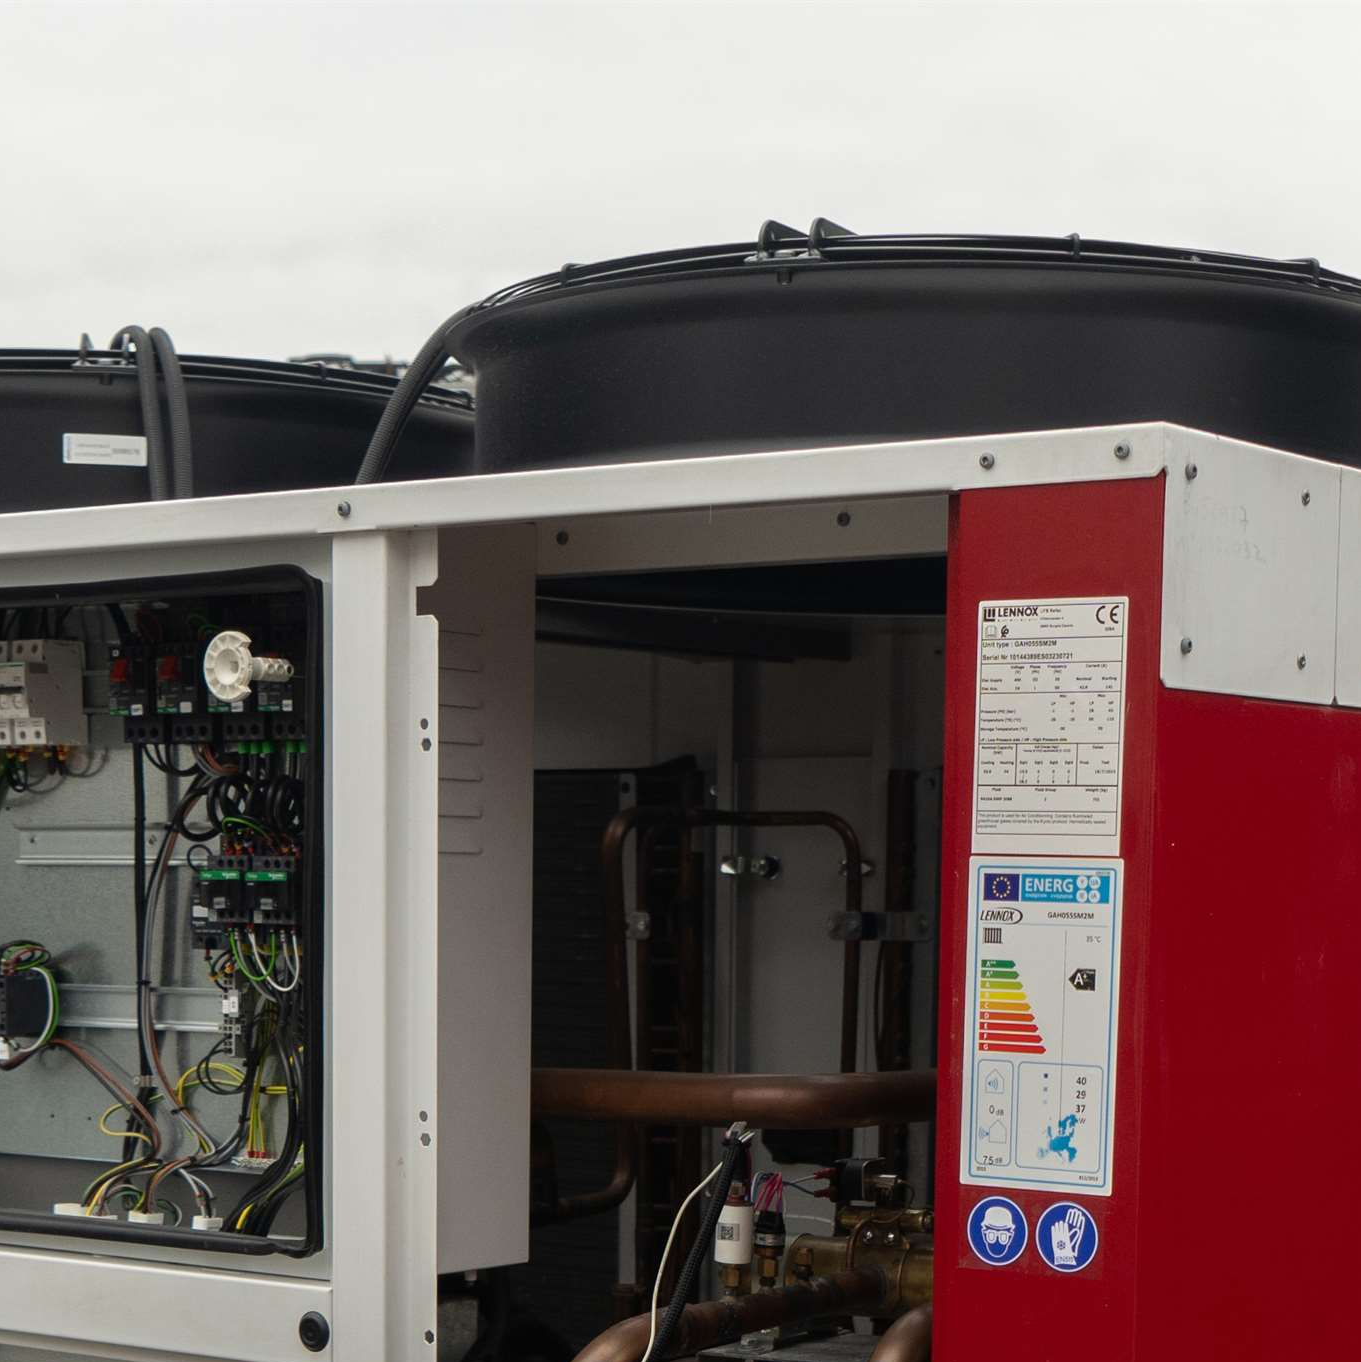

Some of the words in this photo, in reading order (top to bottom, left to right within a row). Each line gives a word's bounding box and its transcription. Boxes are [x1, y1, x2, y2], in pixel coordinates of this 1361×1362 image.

[998, 606, 1038, 618] LENNOX
[996, 641, 1009, 649] type
[1025, 878, 1074, 893] ENERG
[980, 910, 1015, 922] LENNOX
[1076, 1076, 1087, 1086] 40
[1076, 1090, 1086, 1100] 29
[1075, 1104, 1086, 1114] 37
[983, 1155, 994, 1165] 75
